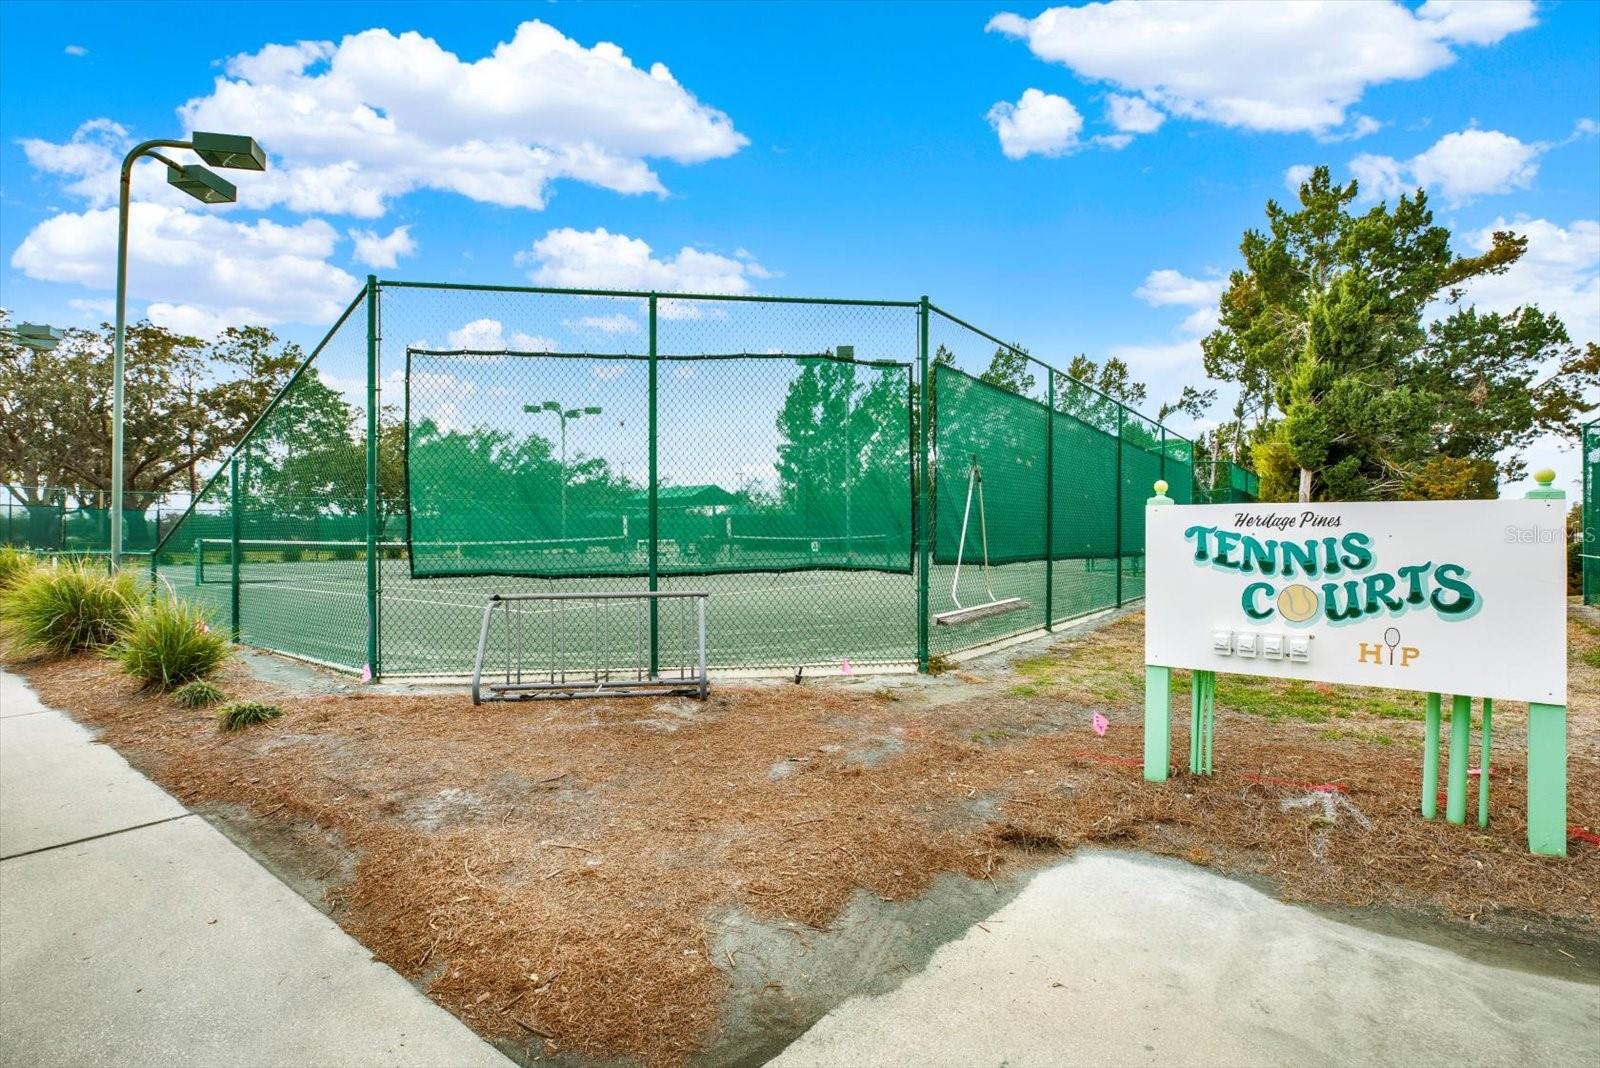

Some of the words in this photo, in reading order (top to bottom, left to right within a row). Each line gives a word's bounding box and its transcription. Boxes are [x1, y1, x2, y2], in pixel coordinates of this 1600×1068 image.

[1234, 512, 1297, 531] Heritage
[1299, 511, 1342, 529] Pines
[1184, 525, 1374, 579] TENNIS
[1241, 561, 1482, 628] COURTS
